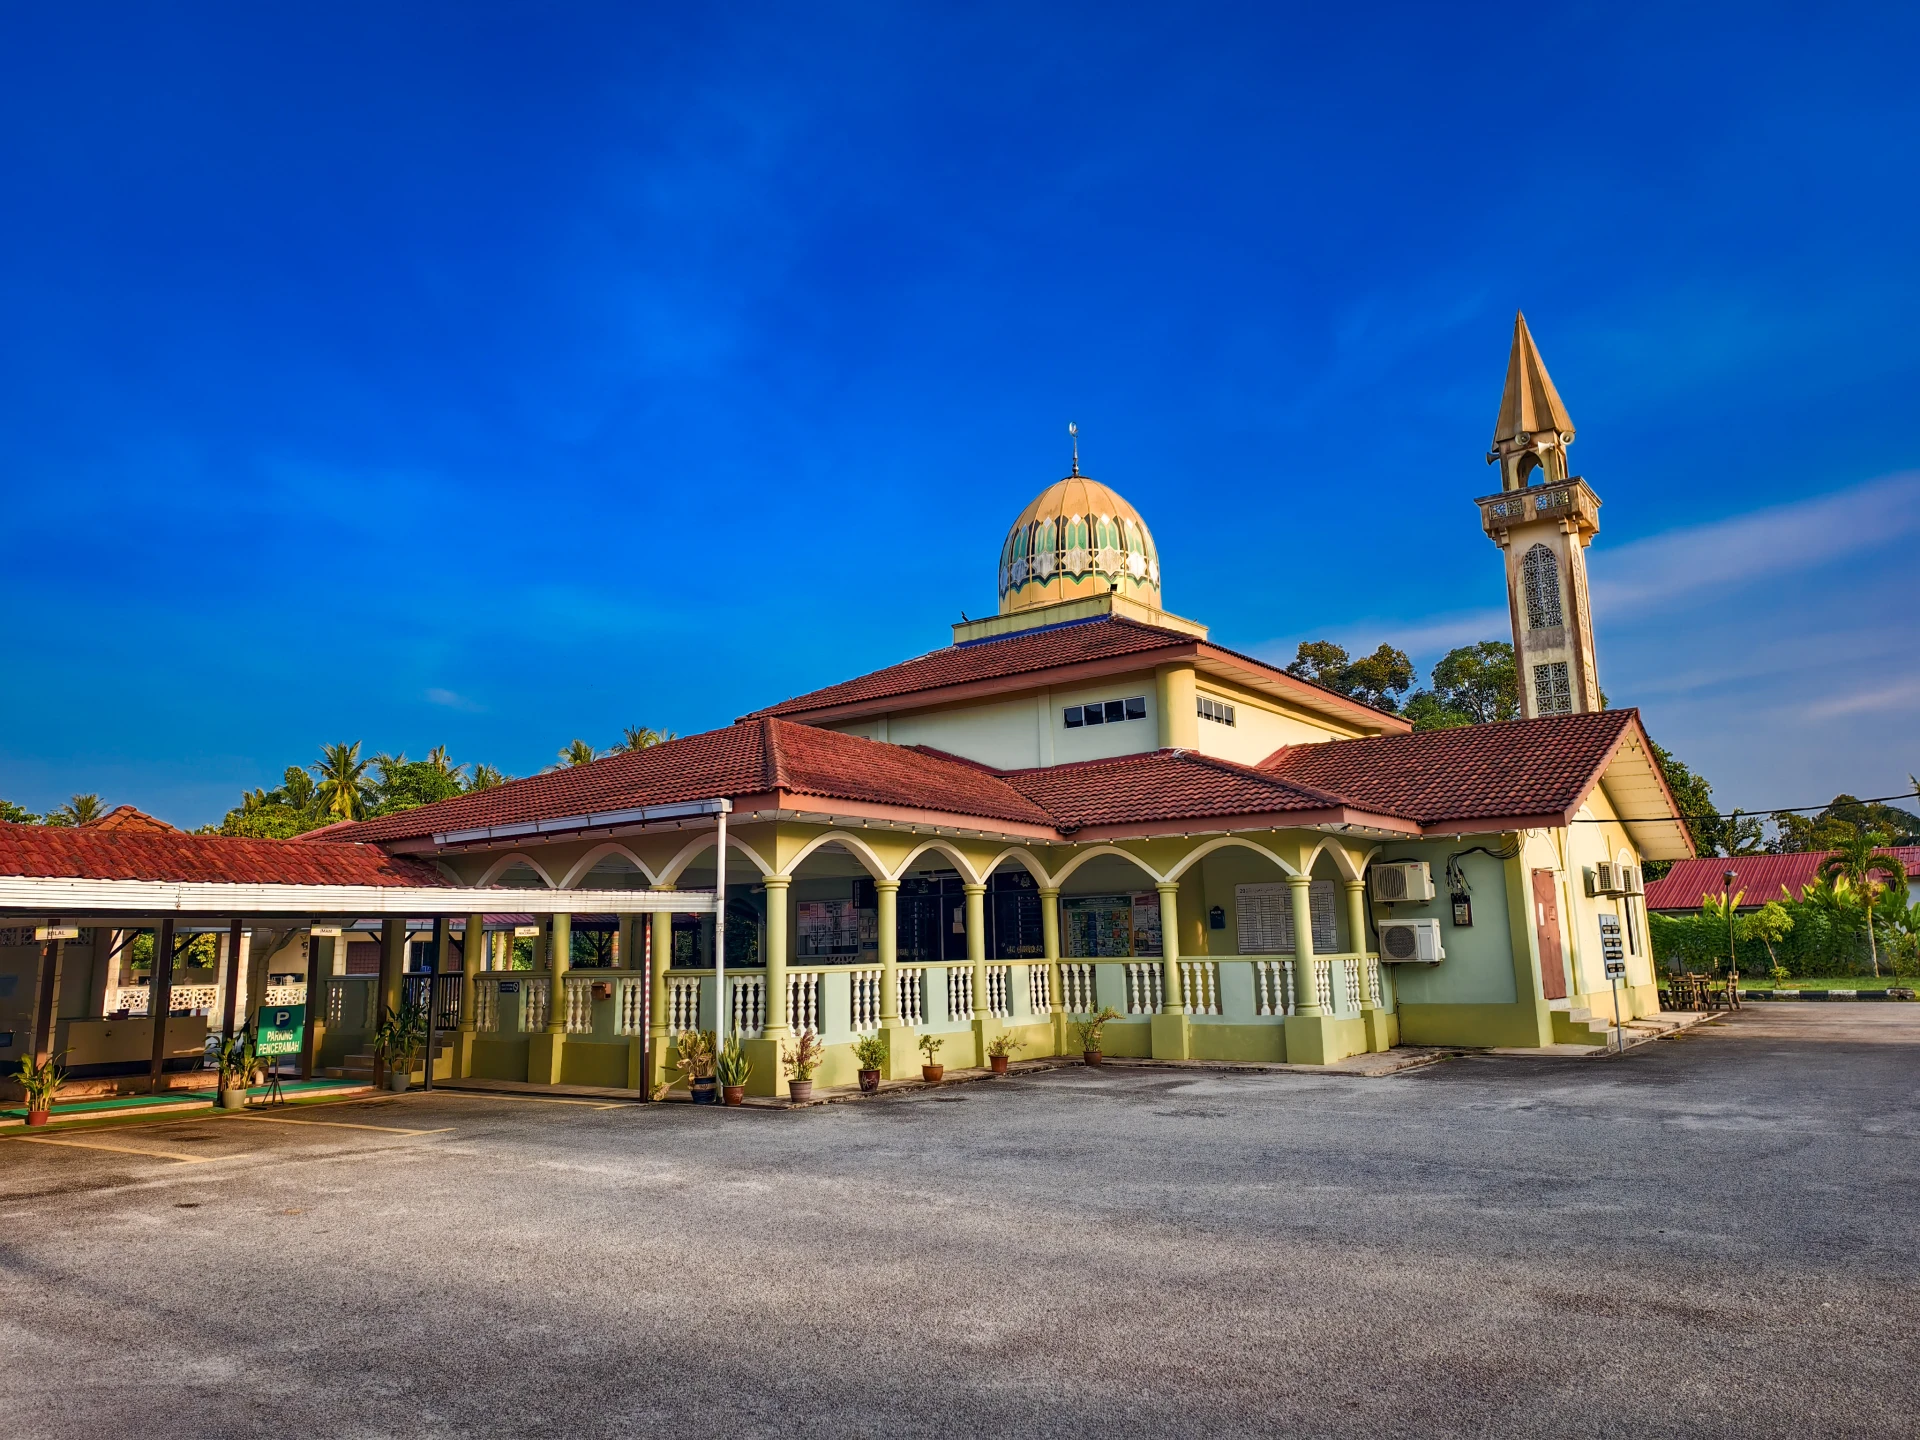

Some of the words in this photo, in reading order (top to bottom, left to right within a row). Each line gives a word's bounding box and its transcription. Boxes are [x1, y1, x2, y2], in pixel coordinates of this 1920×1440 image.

[276, 1012, 290, 1025] P
[267, 1030, 293, 1042] PARKING
[258, 1041, 300, 1055] PENCERAMAH
